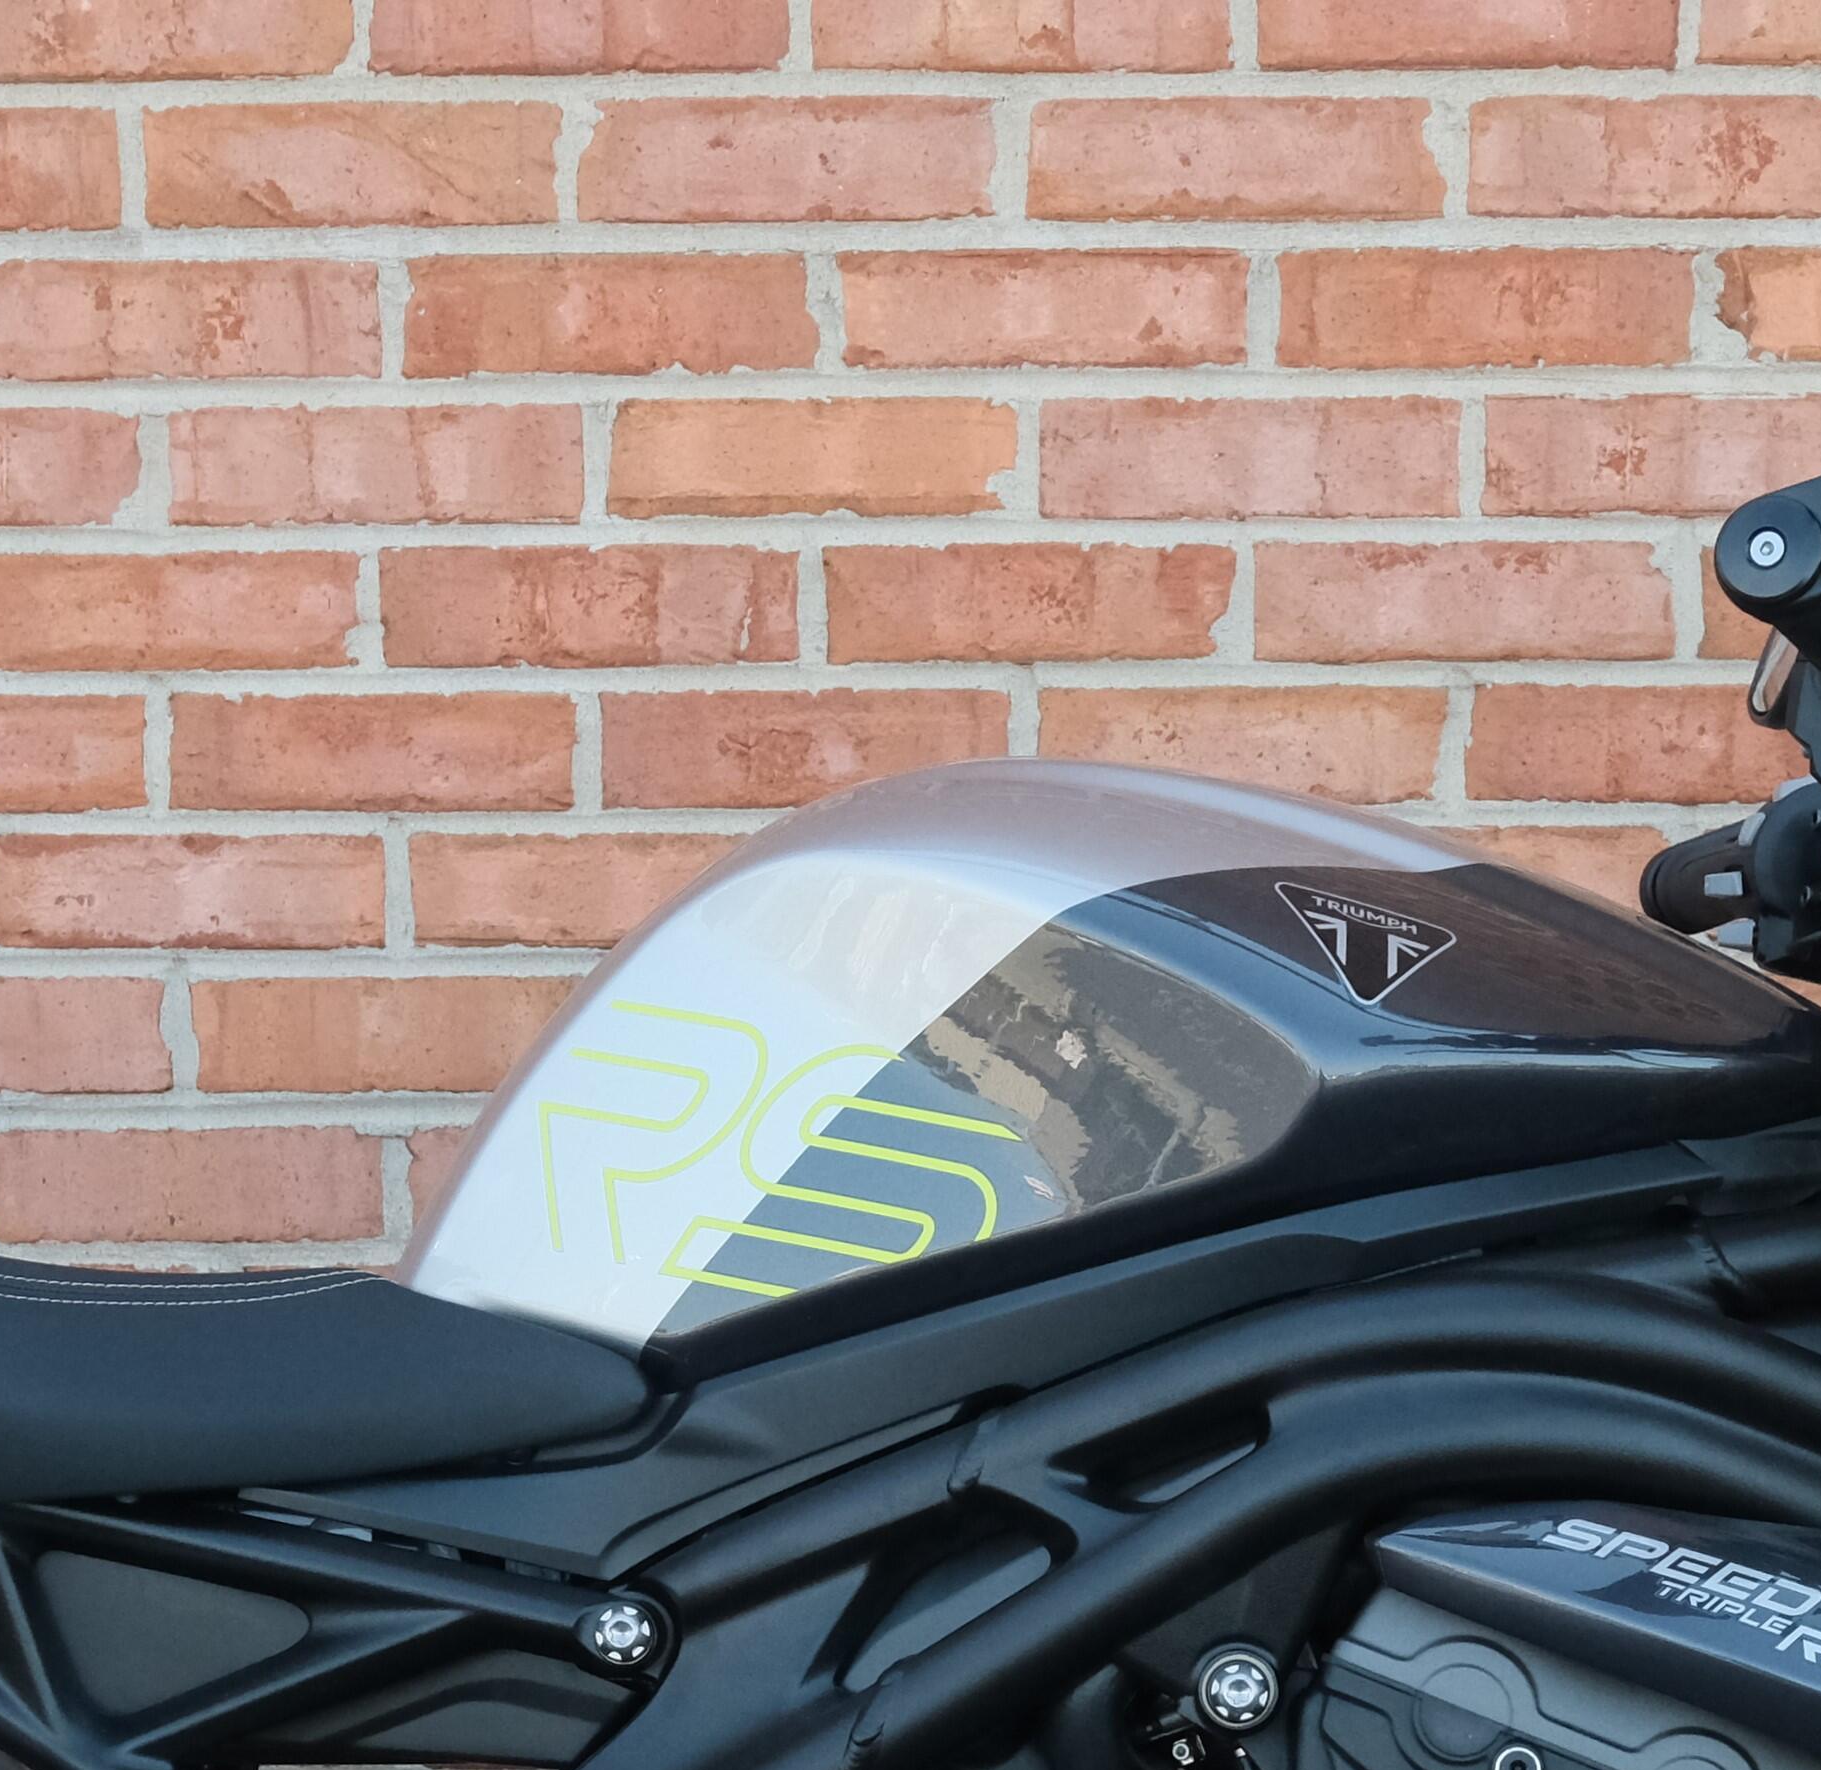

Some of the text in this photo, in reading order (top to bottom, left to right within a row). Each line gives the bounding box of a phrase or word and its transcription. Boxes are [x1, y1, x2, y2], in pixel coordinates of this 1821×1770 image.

[1310, 894, 1419, 936] TRIUMPH
[537, 998, 1023, 1298] RS
[1654, 1579, 1788, 1637] TRIPLE
